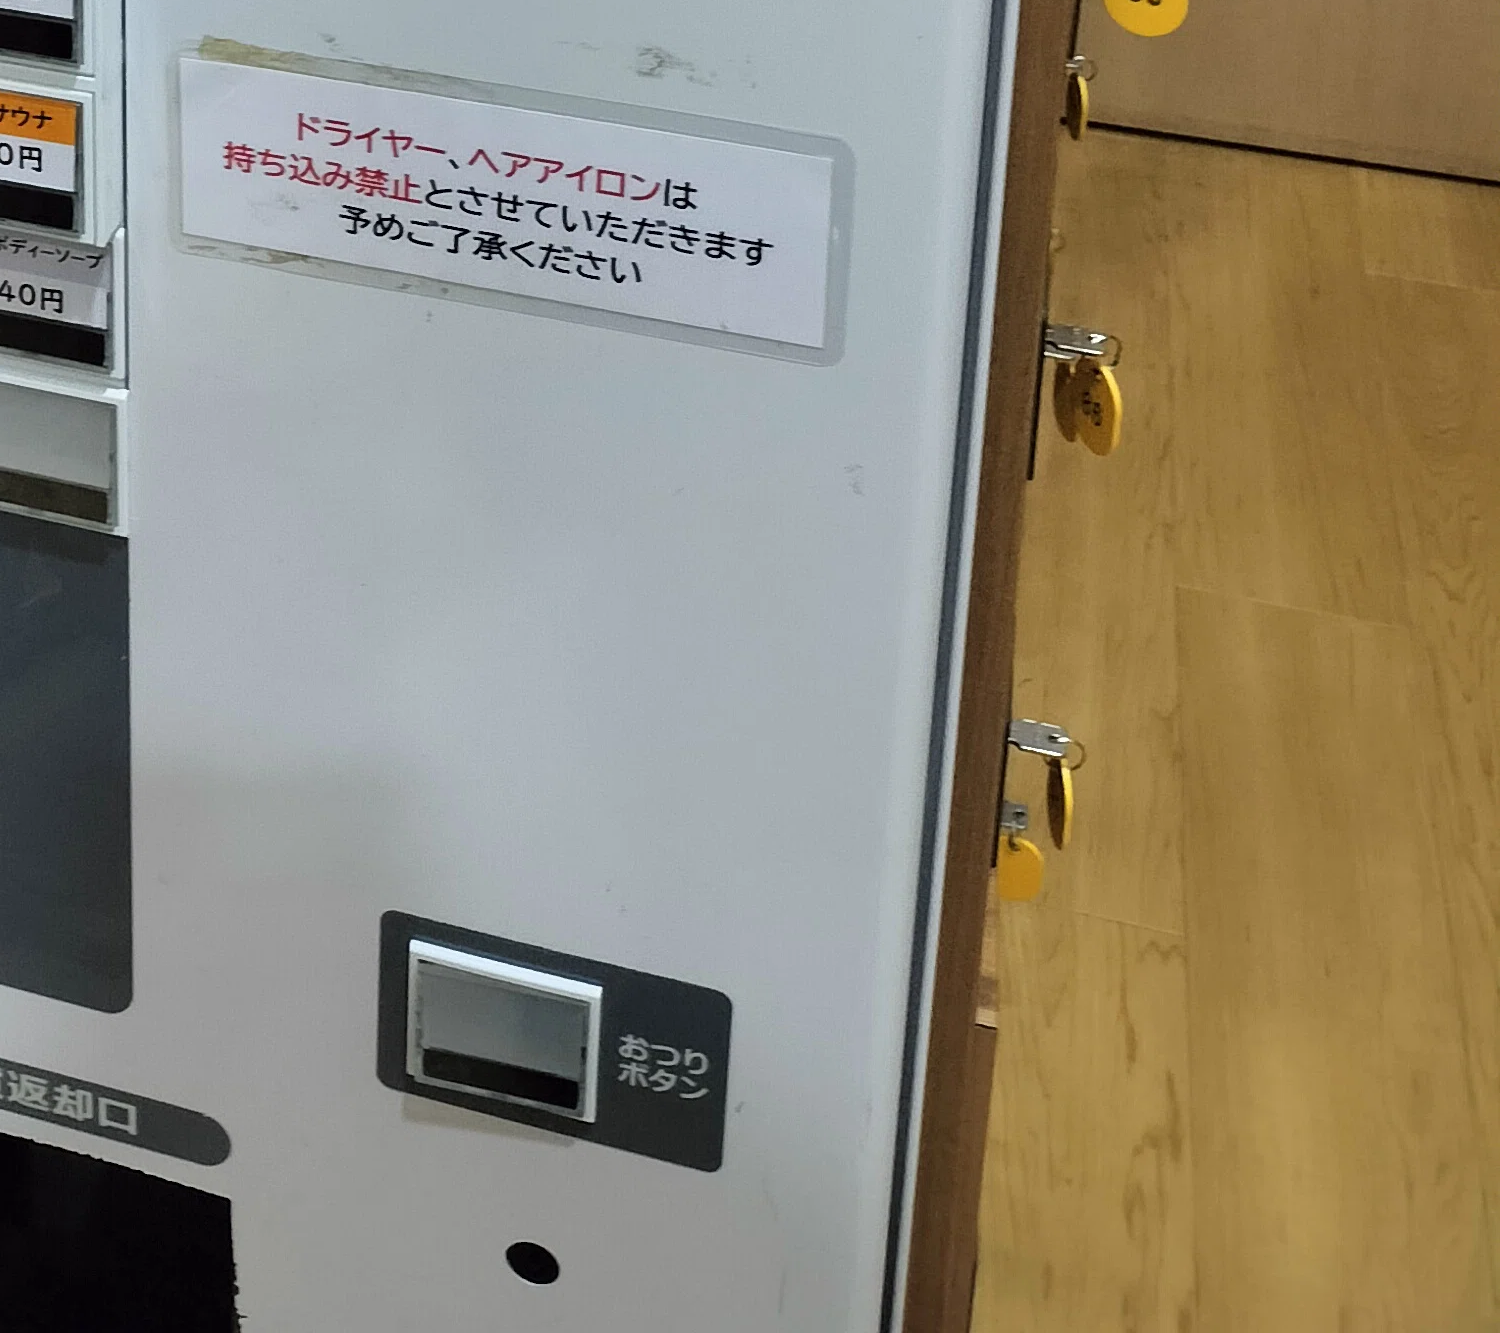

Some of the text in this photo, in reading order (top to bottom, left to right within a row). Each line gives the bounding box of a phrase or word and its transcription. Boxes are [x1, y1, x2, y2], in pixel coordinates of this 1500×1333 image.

[297, 113, 698, 212] ドライヤー、ヘアアイロンは
[223, 142, 774, 267] 持ち込み禁止とさせていただきます
[339, 204, 642, 285] 予めご了承ください
[618, 1034, 709, 1075] おつり
[618, 1062, 710, 1100] ボタン
